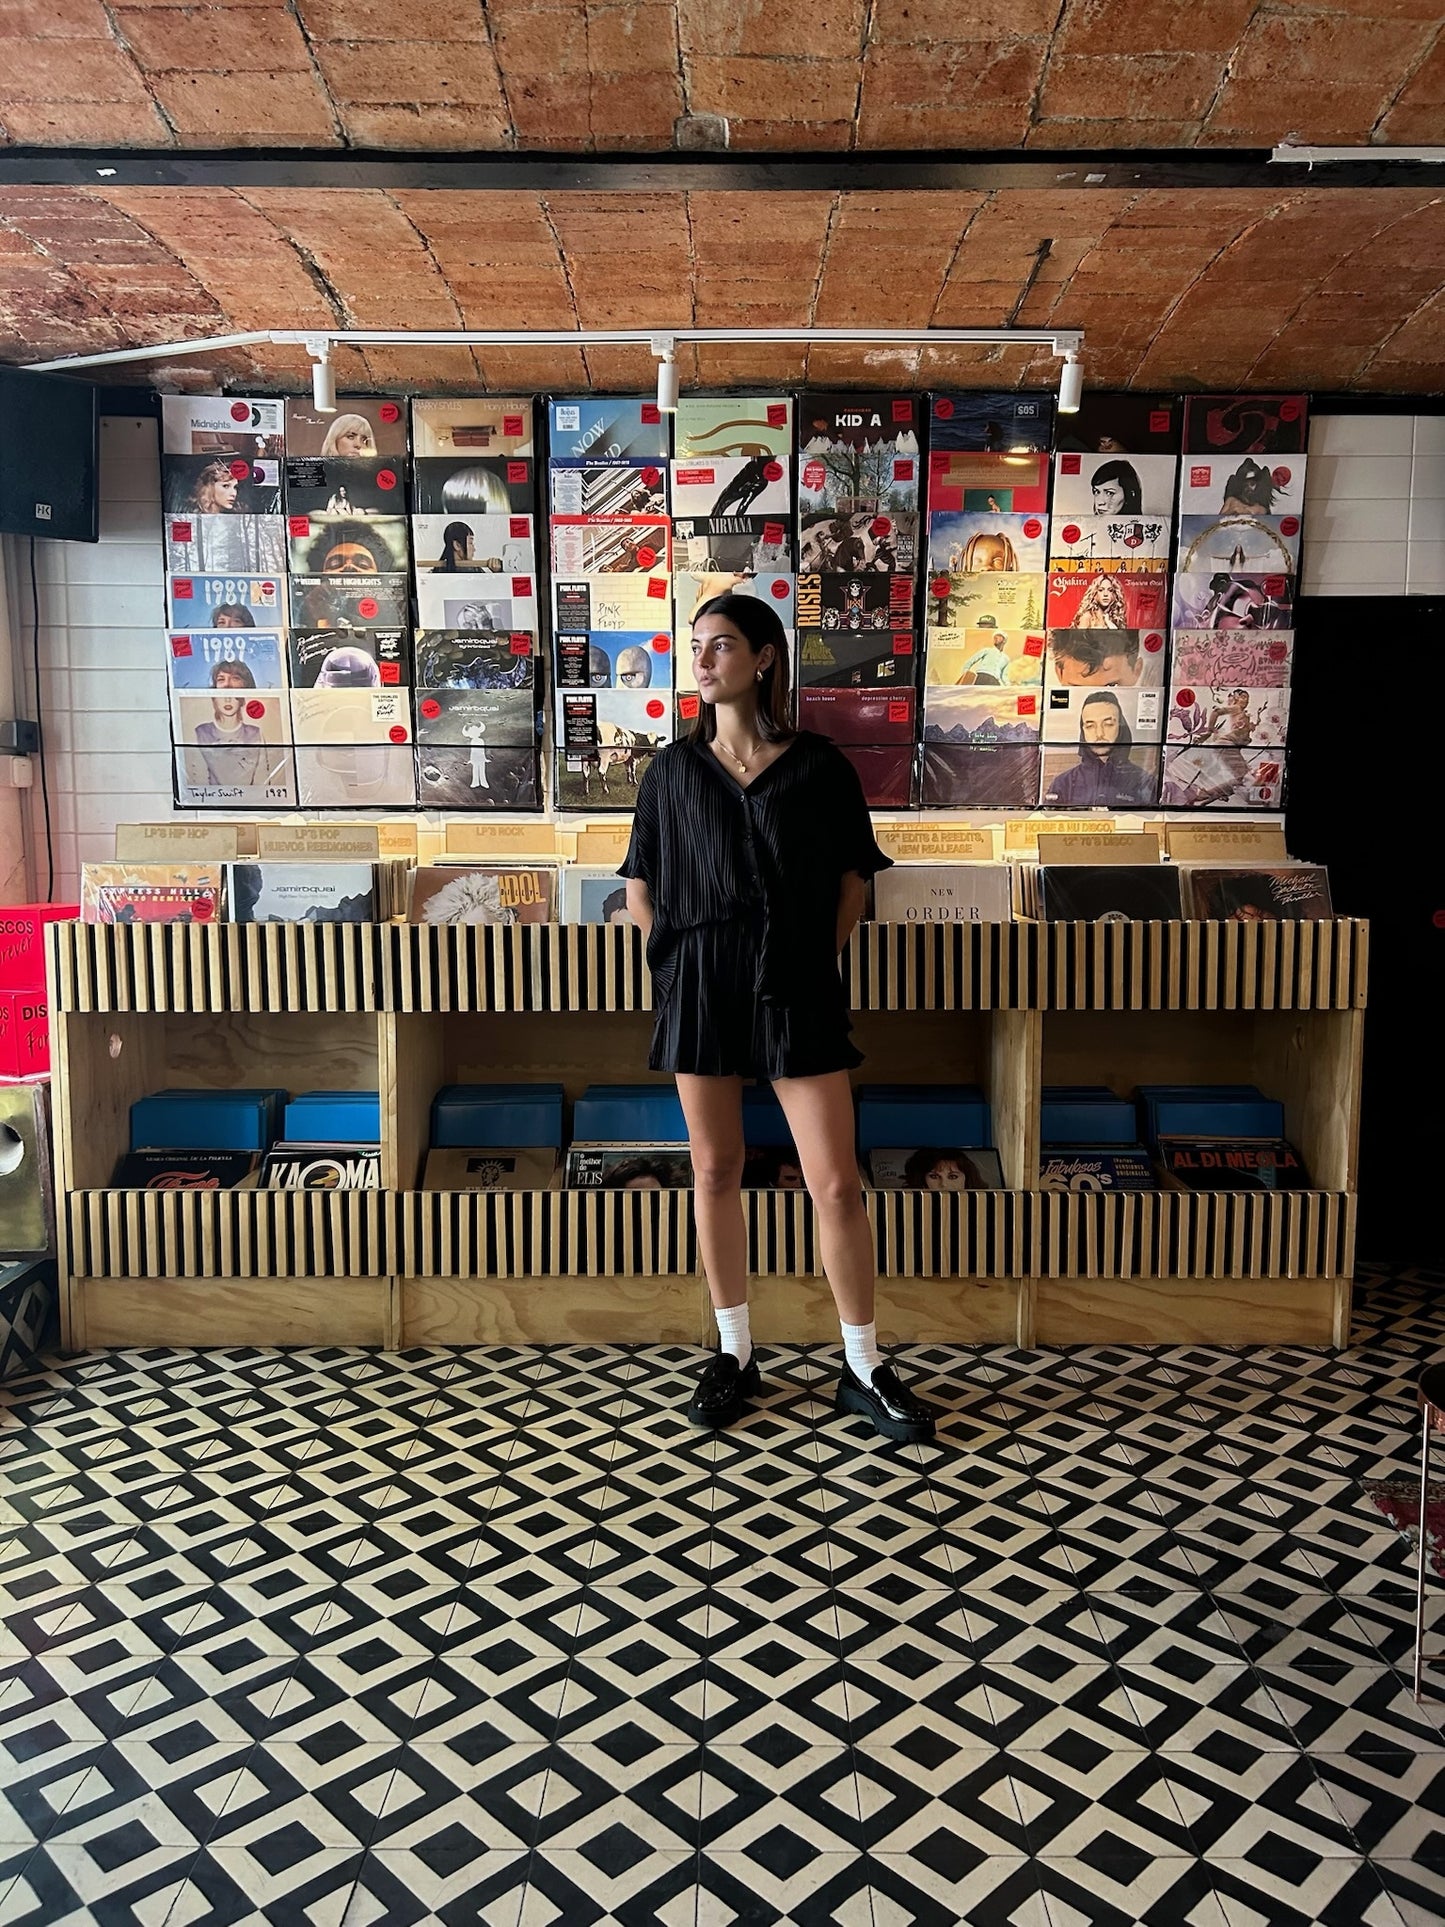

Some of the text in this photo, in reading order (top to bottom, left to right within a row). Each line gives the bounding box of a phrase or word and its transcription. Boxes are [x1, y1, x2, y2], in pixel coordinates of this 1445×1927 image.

[1017, 405, 1035, 415] SOS
[190, 419, 232, 430] Midnights
[835, 413, 882, 427] KID A
[570, 417, 604, 458] NOW
[708, 517, 753, 534] NIRVANA
[328, 578, 342, 586] THE
[343, 578, 381, 586] HIGHLIGHTS
[1050, 576, 1088, 597] Shakira
[205, 579, 248, 605] 1989
[797, 573, 822, 627] ROSES
[598, 602, 621, 616] PINK
[597, 615, 626, 629] FLOYD
[203, 636, 246, 662] 1989
[187, 787, 244, 803] Taylor Swift
[265, 788, 288, 798] 1989
[169, 828, 185, 839] HIP
[187, 828, 209, 839] HOP
[319, 829, 340, 839] POP
[498, 826, 525, 836] ROCK
[1025, 823, 1056, 832] HOUSE
[902, 832, 930, 843] EDITS
[1103, 836, 1134, 846] DISCO
[264, 841, 373, 852] NUEVOS REEDICIONES
[897, 844, 920, 854] NEW
[1268, 873, 1320, 887] Michael
[271, 885, 336, 893] Jamiroquai
[499, 872, 546, 907] IDOL
[930, 888, 954, 896] NEW
[1271, 883, 1323, 901] Jackson
[1281, 892, 1324, 905] Thriller
[906, 906, 980, 920] ORDER
[0, 920, 34, 935] SCOS
[22, 1005, 48, 1020] DIS
[1045, 1158, 1102, 1175] Fabulosos
[1173, 1151, 1298, 1169] AL DI MEOLA
[268, 1159, 381, 1189] KAOMA
[577, 1171, 603, 1185] ELIS
